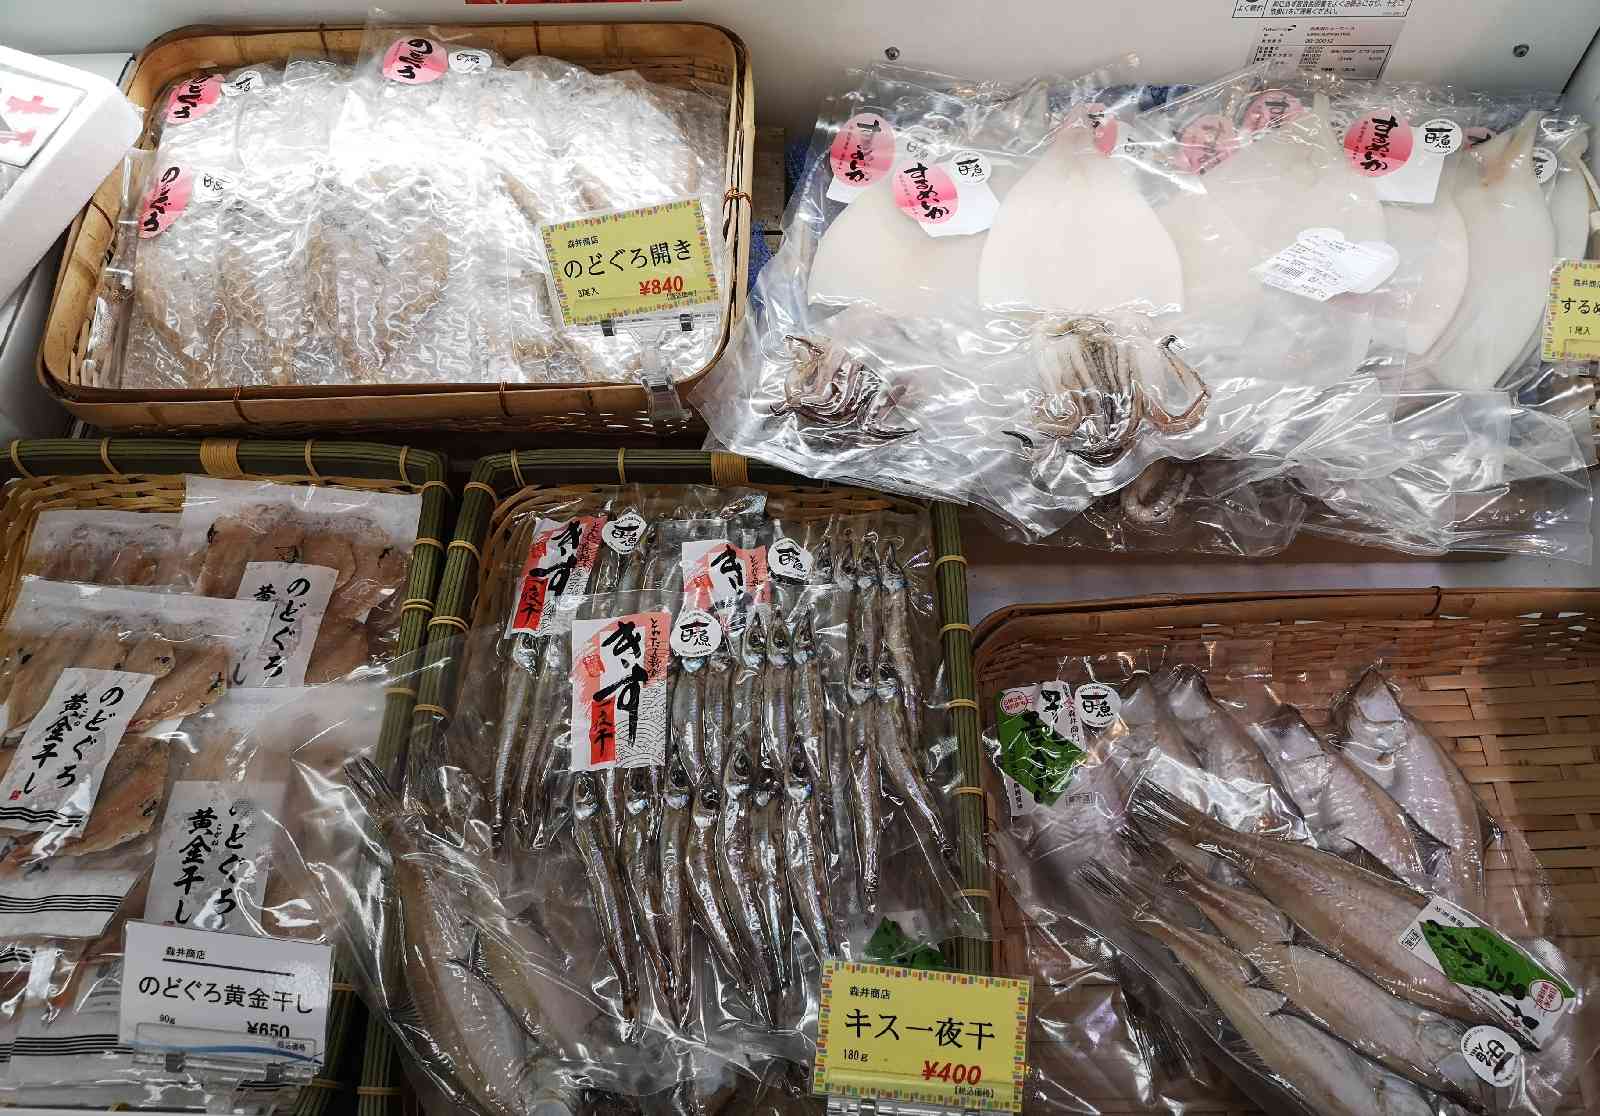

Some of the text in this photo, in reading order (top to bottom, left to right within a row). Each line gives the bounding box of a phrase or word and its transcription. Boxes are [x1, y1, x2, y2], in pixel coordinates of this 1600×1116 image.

[1360, 115, 1399, 172] するめいか
[904, 162, 950, 219] するめいか
[563, 239, 692, 279] のどぐろ開き
[567, 236, 600, 249] 森井商店
[639, 275, 684, 296] ¥840
[263, 578, 311, 679] のどぐろ
[592, 620, 648, 748] きす
[24, 692, 89, 795] 黄金干し
[56, 686, 125, 789] のどぐろ
[173, 806, 218, 924] 黄金干し
[166, 946, 206, 960] 森井商店
[138, 975, 313, 1015] のどぐろ黄金干し
[849, 985, 891, 1000] 森井商店
[246, 1020, 291, 1040] ¥650
[844, 1008, 996, 1051] キス一夜干
[920, 1060, 983, 1086] ¥400
